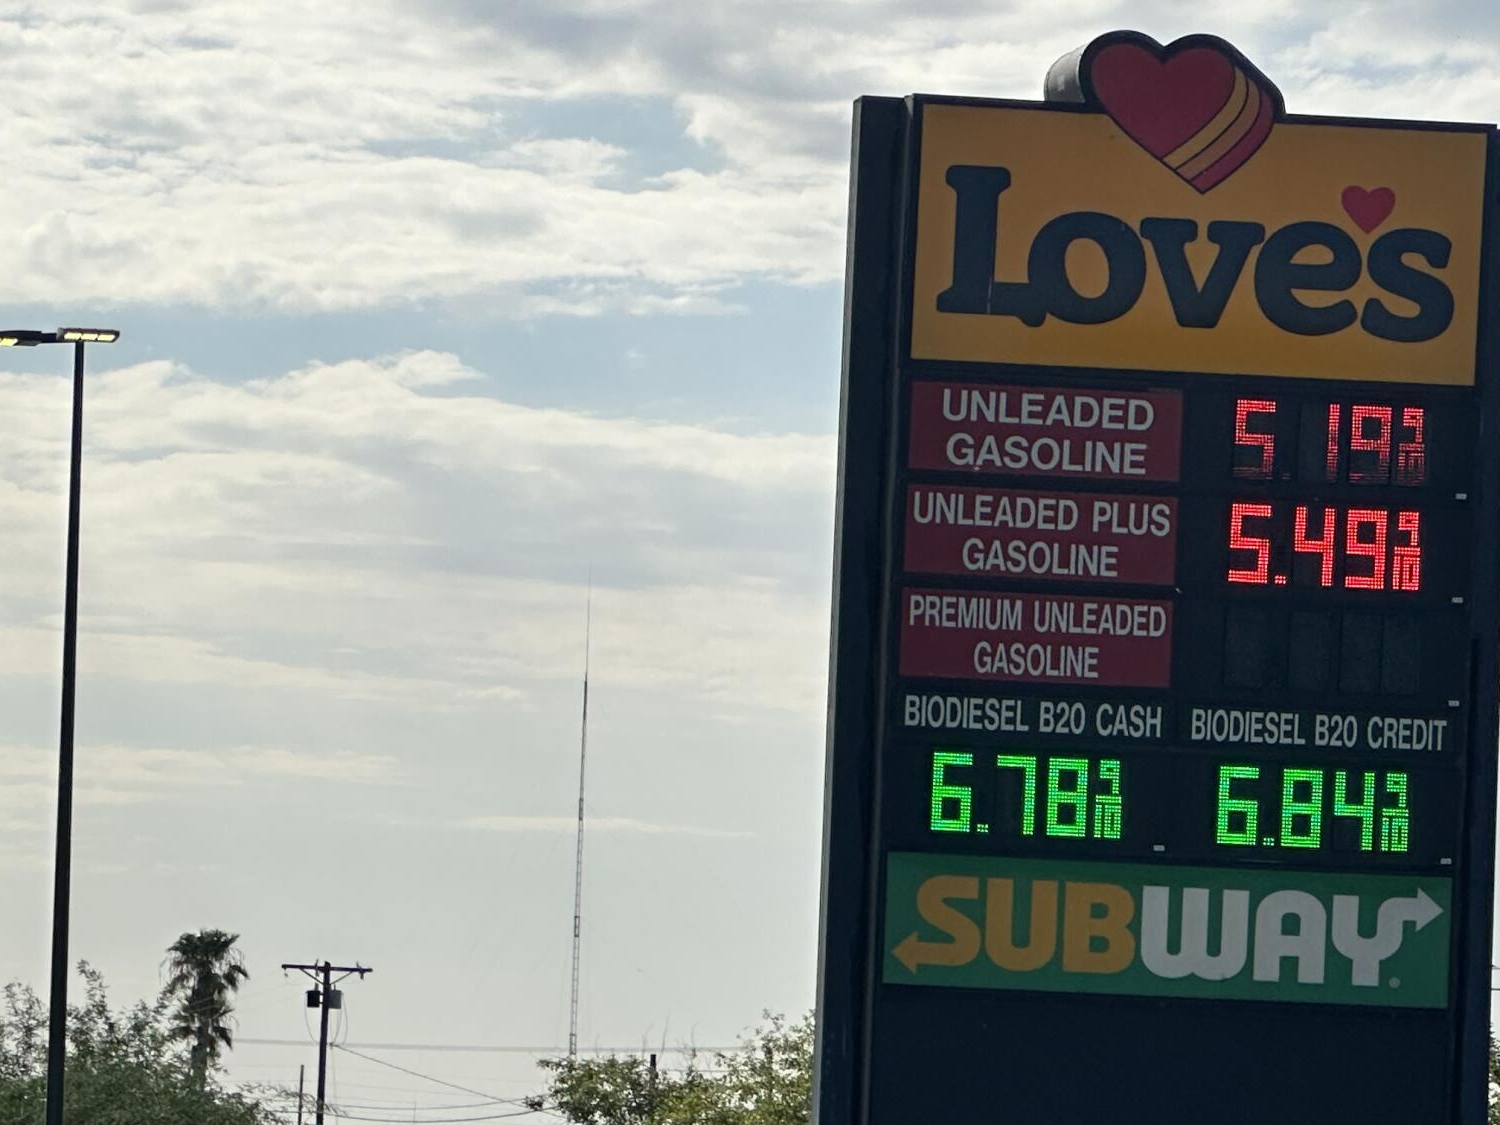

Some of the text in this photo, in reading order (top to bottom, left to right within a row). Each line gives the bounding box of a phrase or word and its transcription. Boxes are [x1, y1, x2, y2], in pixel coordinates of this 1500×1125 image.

[943, 388, 1155, 431] UNLEADED
[946, 432, 1148, 475] GASOLINE
[913, 491, 1171, 537] UNLEADED PLUS
[962, 538, 1119, 577] GASOLINE
[1228, 503, 1388, 590] 5.49
[909, 595, 1167, 637] PREMIUM UNLEADED
[973, 641, 1099, 679] GASOLINE
[904, 695, 1162, 738] BIODIESEL B20 CASH
[1191, 708, 1447, 751] BIODIESEL B20 CREDIT
[931, 752, 1089, 837] 6.78
[1217, 765, 1376, 851] 6.84
[892, 873, 1444, 987] SUBWAY
